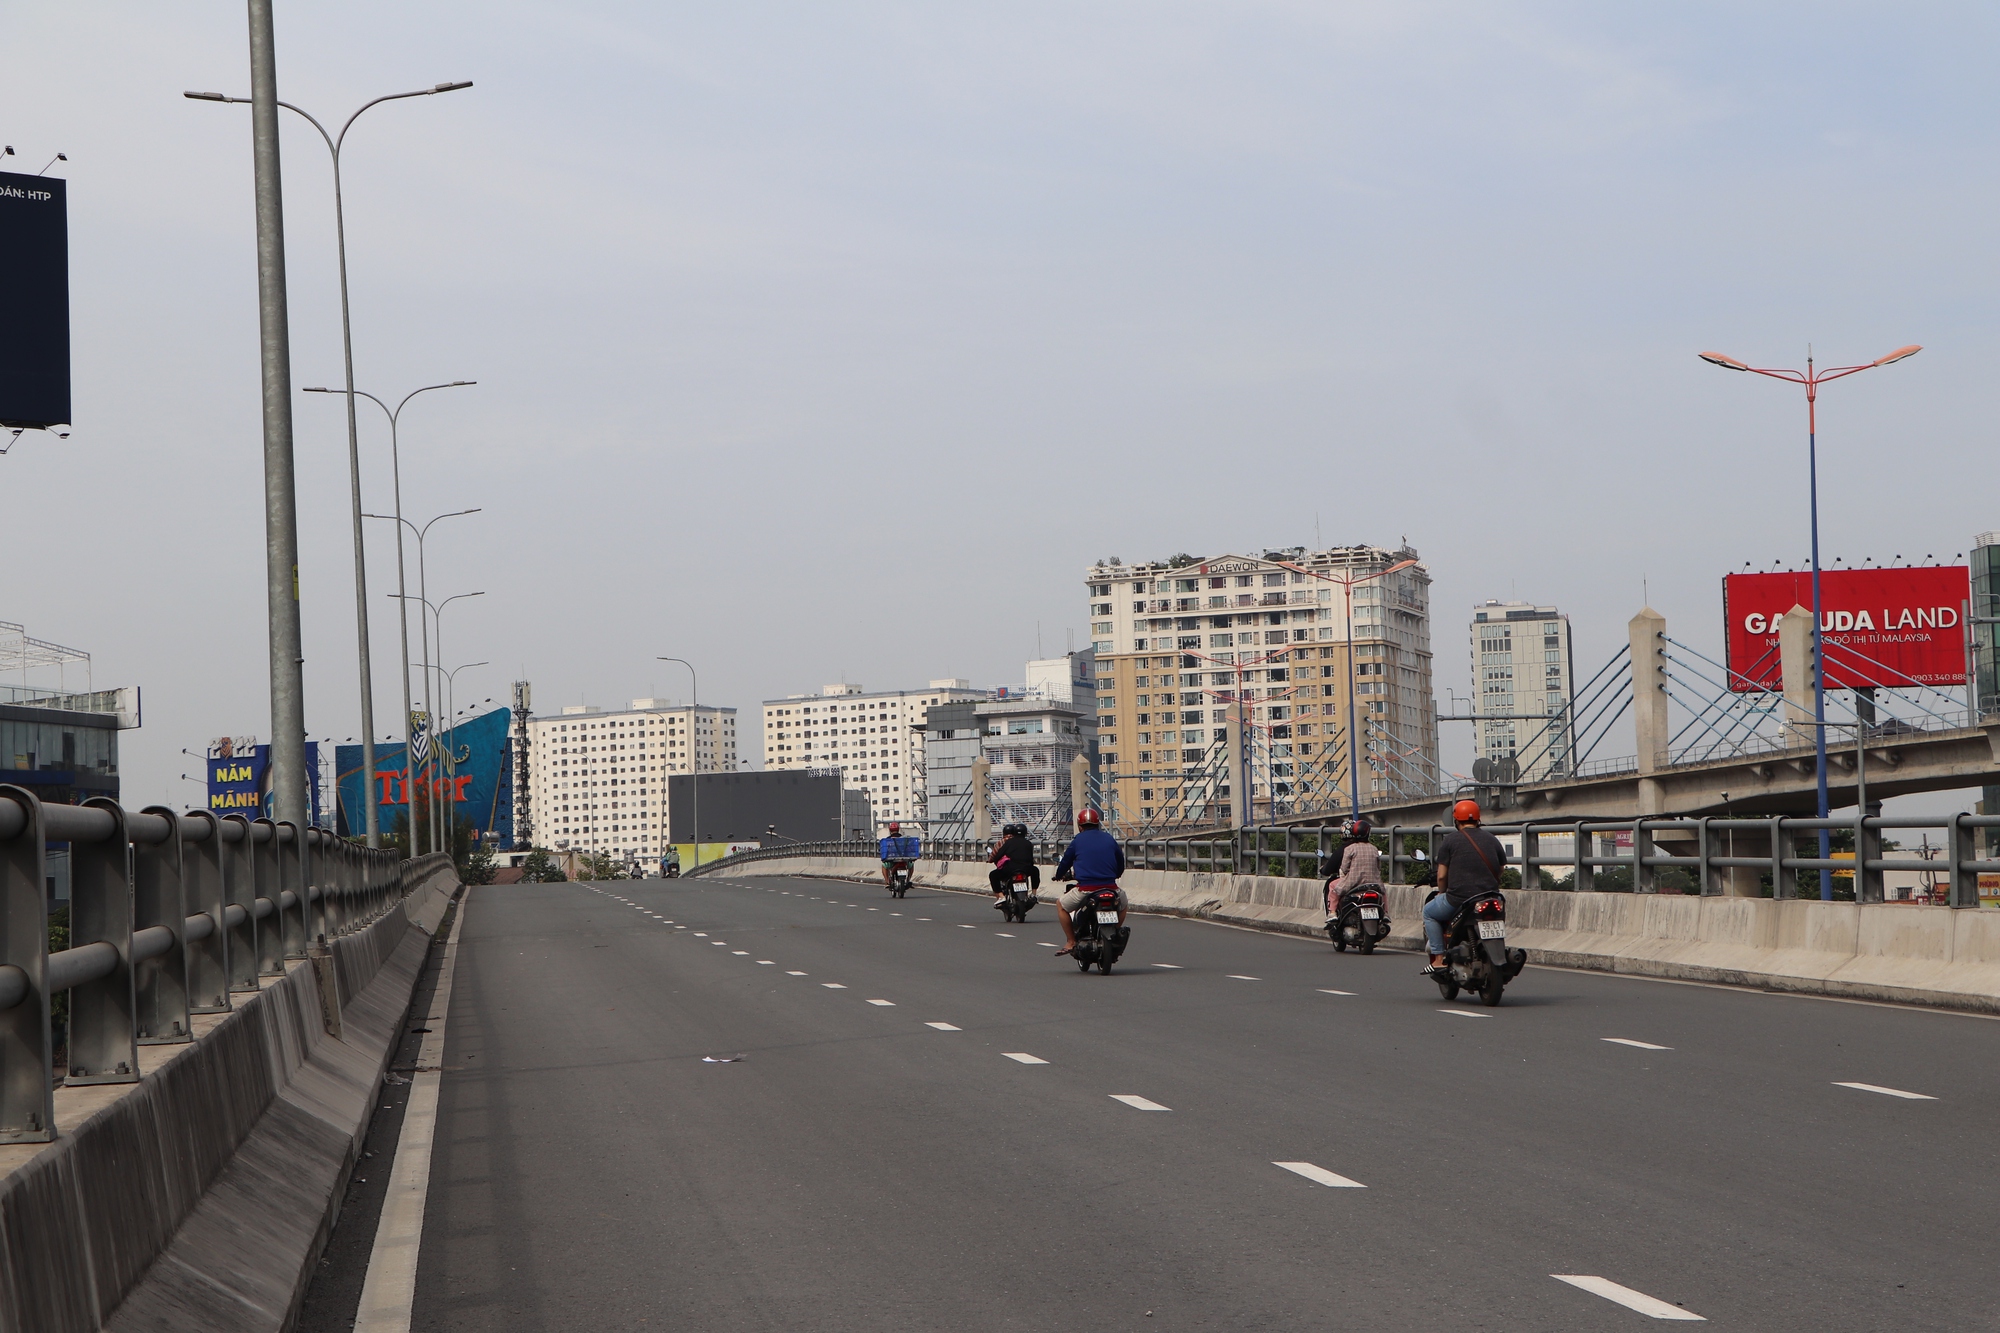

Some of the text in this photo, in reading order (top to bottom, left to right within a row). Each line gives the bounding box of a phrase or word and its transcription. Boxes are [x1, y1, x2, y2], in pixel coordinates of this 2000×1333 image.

[28, 190, 52, 201] HTP
[1210, 561, 1259, 573] DAEWON
[1745, 606, 1958, 634] GAUDA LAND
[1882, 633, 1932, 643] MALAYSIA
[1911, 674, 1933, 682] 0903
[1934, 673, 1951, 681] 340
[216, 763, 252, 783] NĂM
[211, 790, 259, 809] MÃNH
